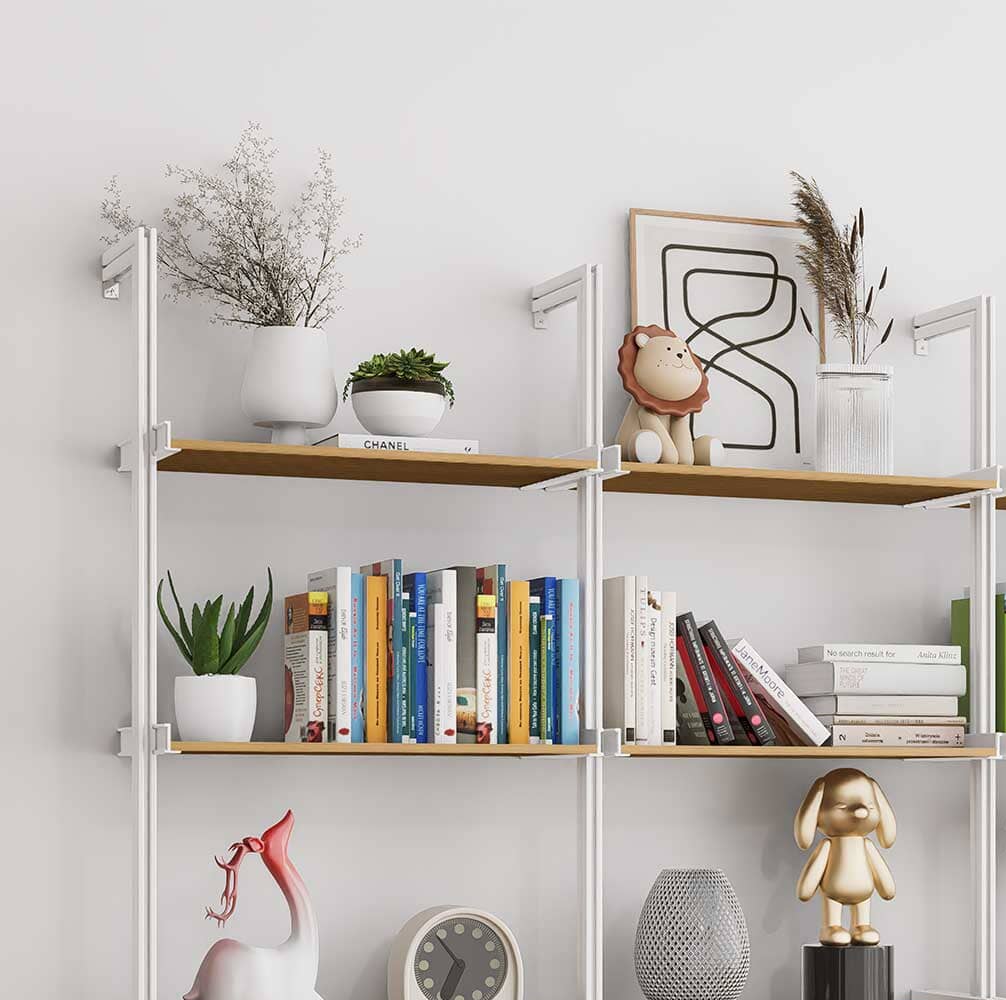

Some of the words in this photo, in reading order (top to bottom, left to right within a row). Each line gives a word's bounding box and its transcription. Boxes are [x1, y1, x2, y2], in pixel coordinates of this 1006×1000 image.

[364, 440, 409, 450] CHANEL
[649, 617, 657, 640] Design
[885, 650, 896, 658] for
[917, 651, 936, 659] Anita
